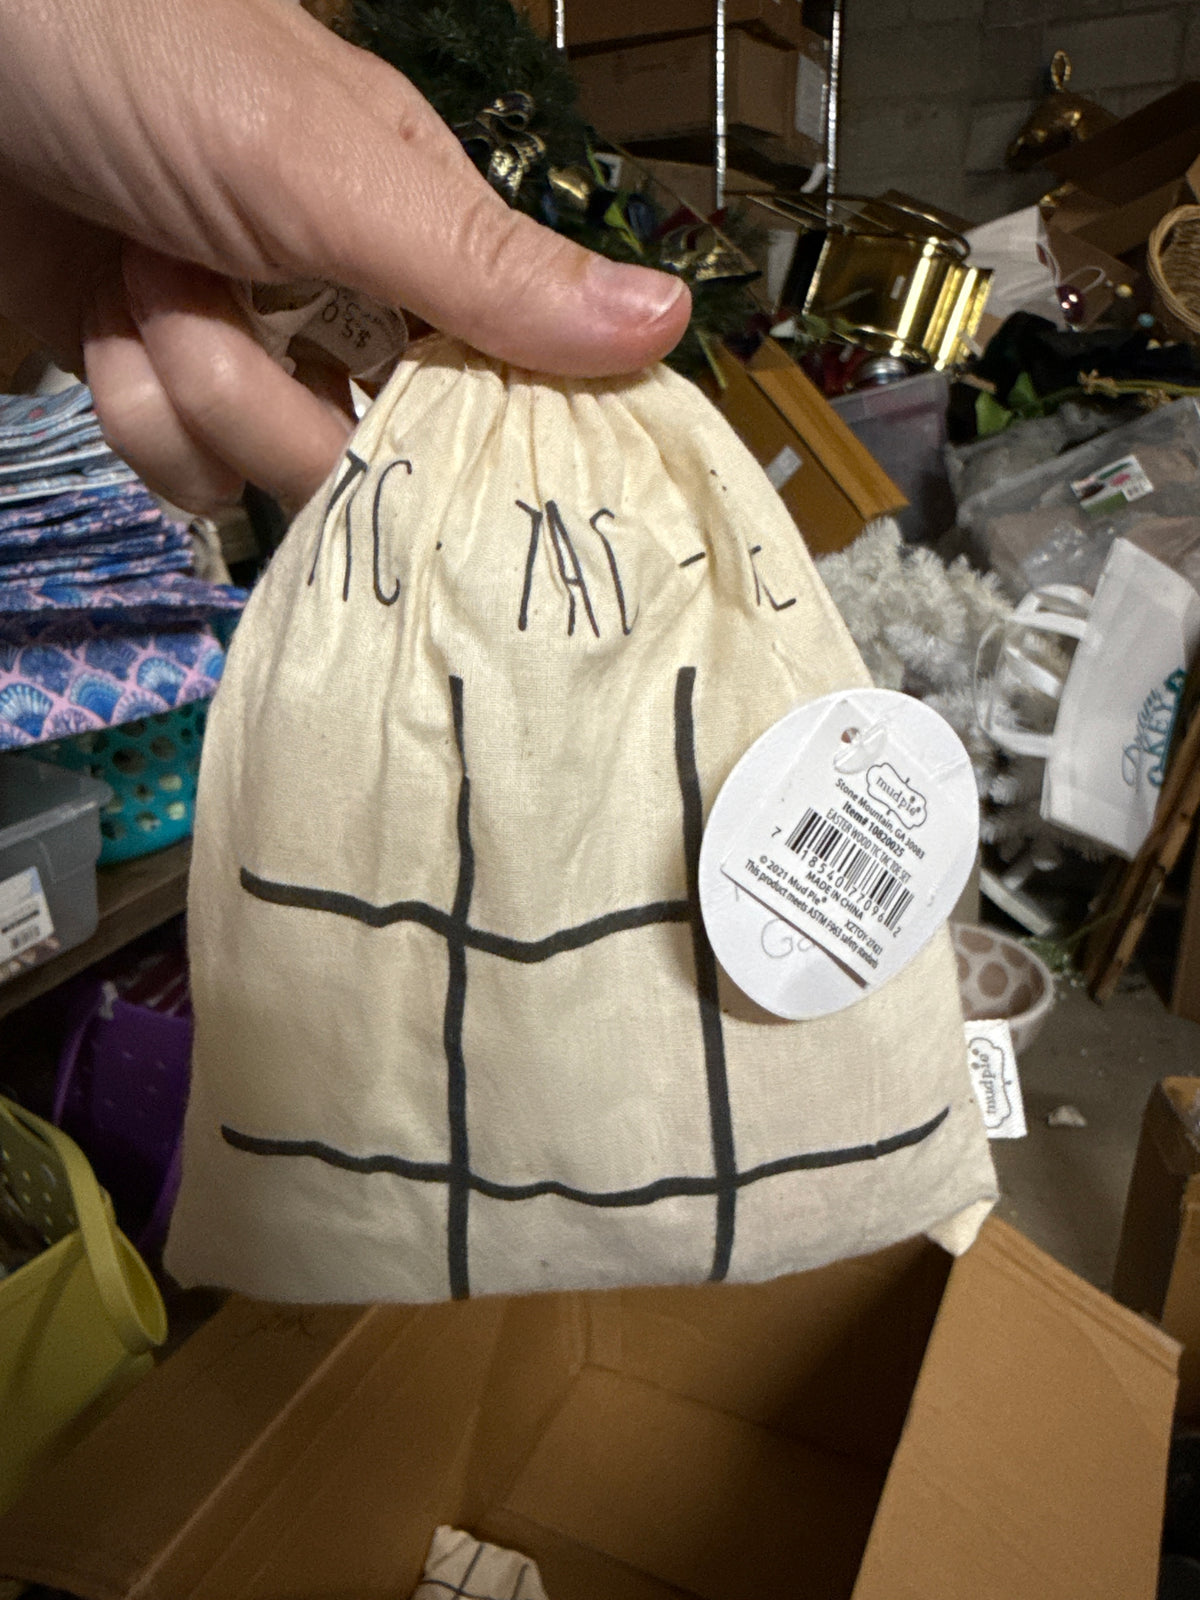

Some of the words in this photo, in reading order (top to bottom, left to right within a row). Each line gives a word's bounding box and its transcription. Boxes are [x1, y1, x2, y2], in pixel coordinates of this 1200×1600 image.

[771, 826, 782, 837] 7
[825, 807, 852, 833] EASTER
[850, 827, 872, 849] WOOD
[870, 843, 882, 857] TIC
[898, 869, 911, 883] SET
[835, 778, 858, 801] Stone
[857, 796, 893, 833] Mountain,
[894, 828, 906, 842] GA
[904, 837, 925, 859] 30083
[842, 800, 869, 826] Item#
[867, 821, 905, 858] 10820025
[745, 858, 760, 876] This
[757, 872, 788, 897] product
[786, 892, 808, 912] meets
[806, 906, 828, 926] ASTM
[839, 933, 859, 952] safety
[766, 860, 788, 880] 2021
[787, 875, 809, 895] Mud
[805, 870, 832, 894] MADE
[830, 889, 841, 902] IN
[839, 897, 863, 920] CHINA
